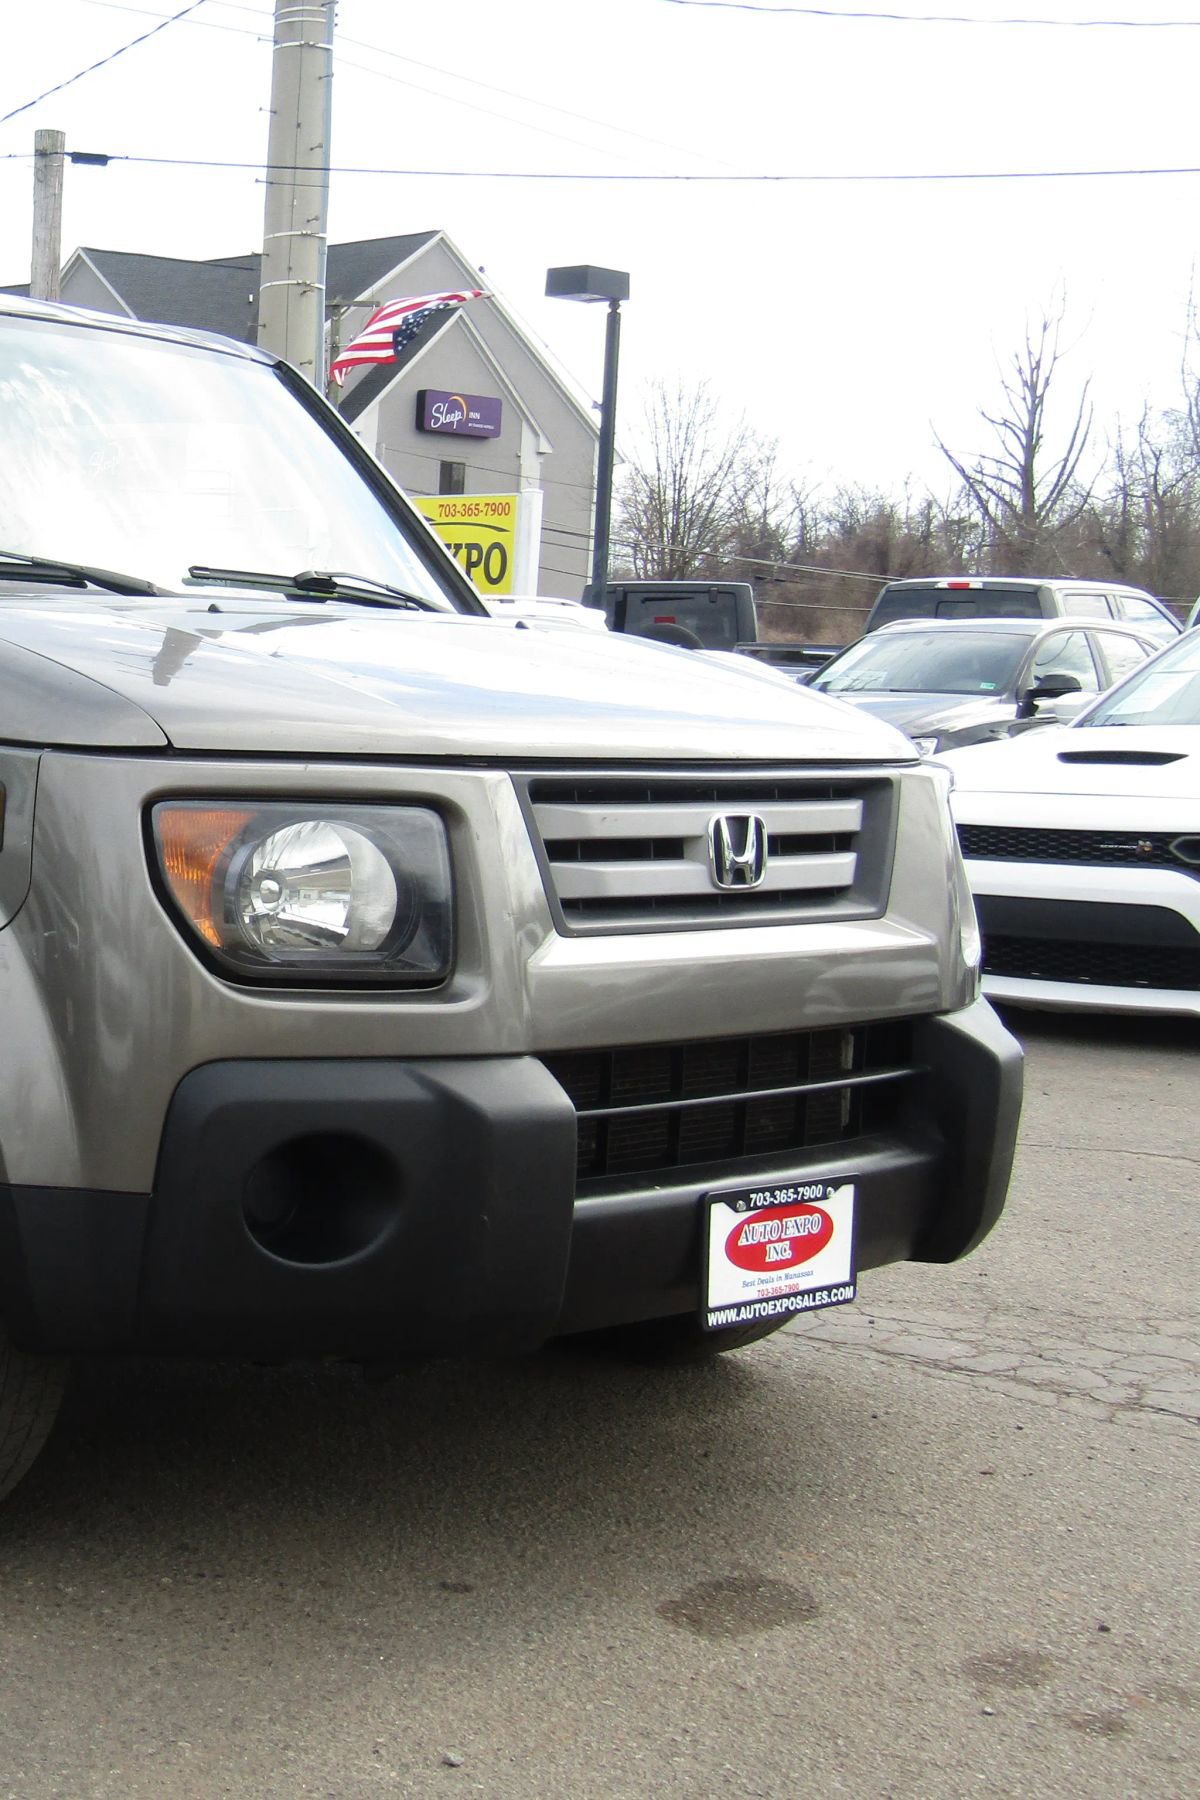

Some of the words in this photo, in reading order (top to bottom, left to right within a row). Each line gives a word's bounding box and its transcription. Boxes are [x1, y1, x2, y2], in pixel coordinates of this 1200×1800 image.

[431, 402, 463, 429] Sleep
[468, 411, 480, 420] INN
[438, 502, 511, 518] 703-365-7900
[750, 1184, 823, 1207] 703-365-7900
[738, 1220, 782, 1246] AUTO
[782, 1213, 822, 1238] EXPO
[765, 1241, 792, 1262] INC.
[757, 1275, 775, 1286] Deals
[757, 1283, 800, 1297] 703-365-7900
[707, 1286, 854, 1327] WWW.AUTOEXPOSALES.COM
